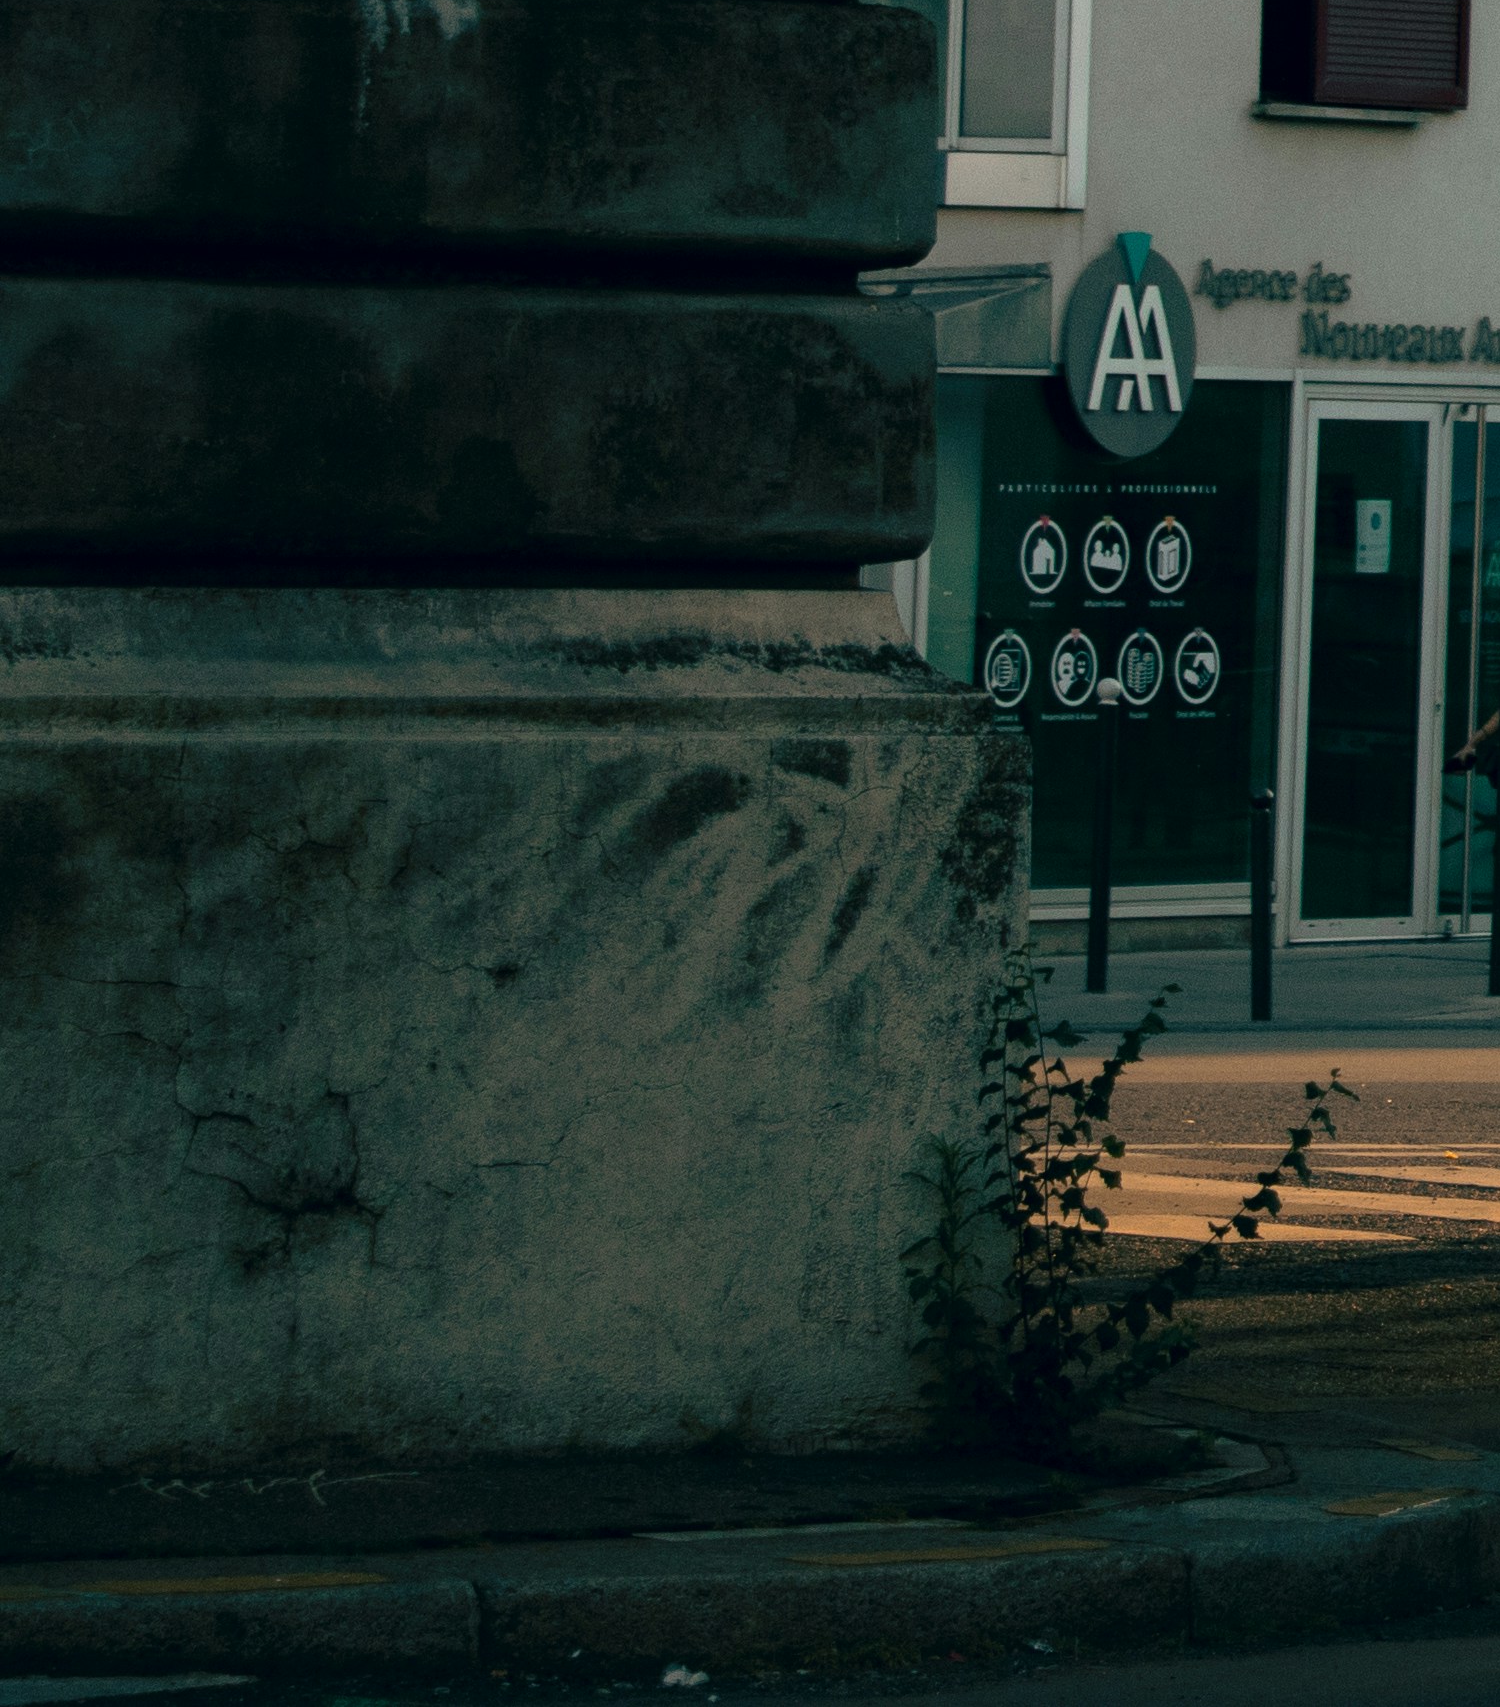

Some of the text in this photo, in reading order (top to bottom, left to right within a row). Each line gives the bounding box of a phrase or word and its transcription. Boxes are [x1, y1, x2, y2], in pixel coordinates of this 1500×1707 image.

[1195, 258, 1352, 308] Agence des
[1300, 307, 1466, 363] Nouveaux
